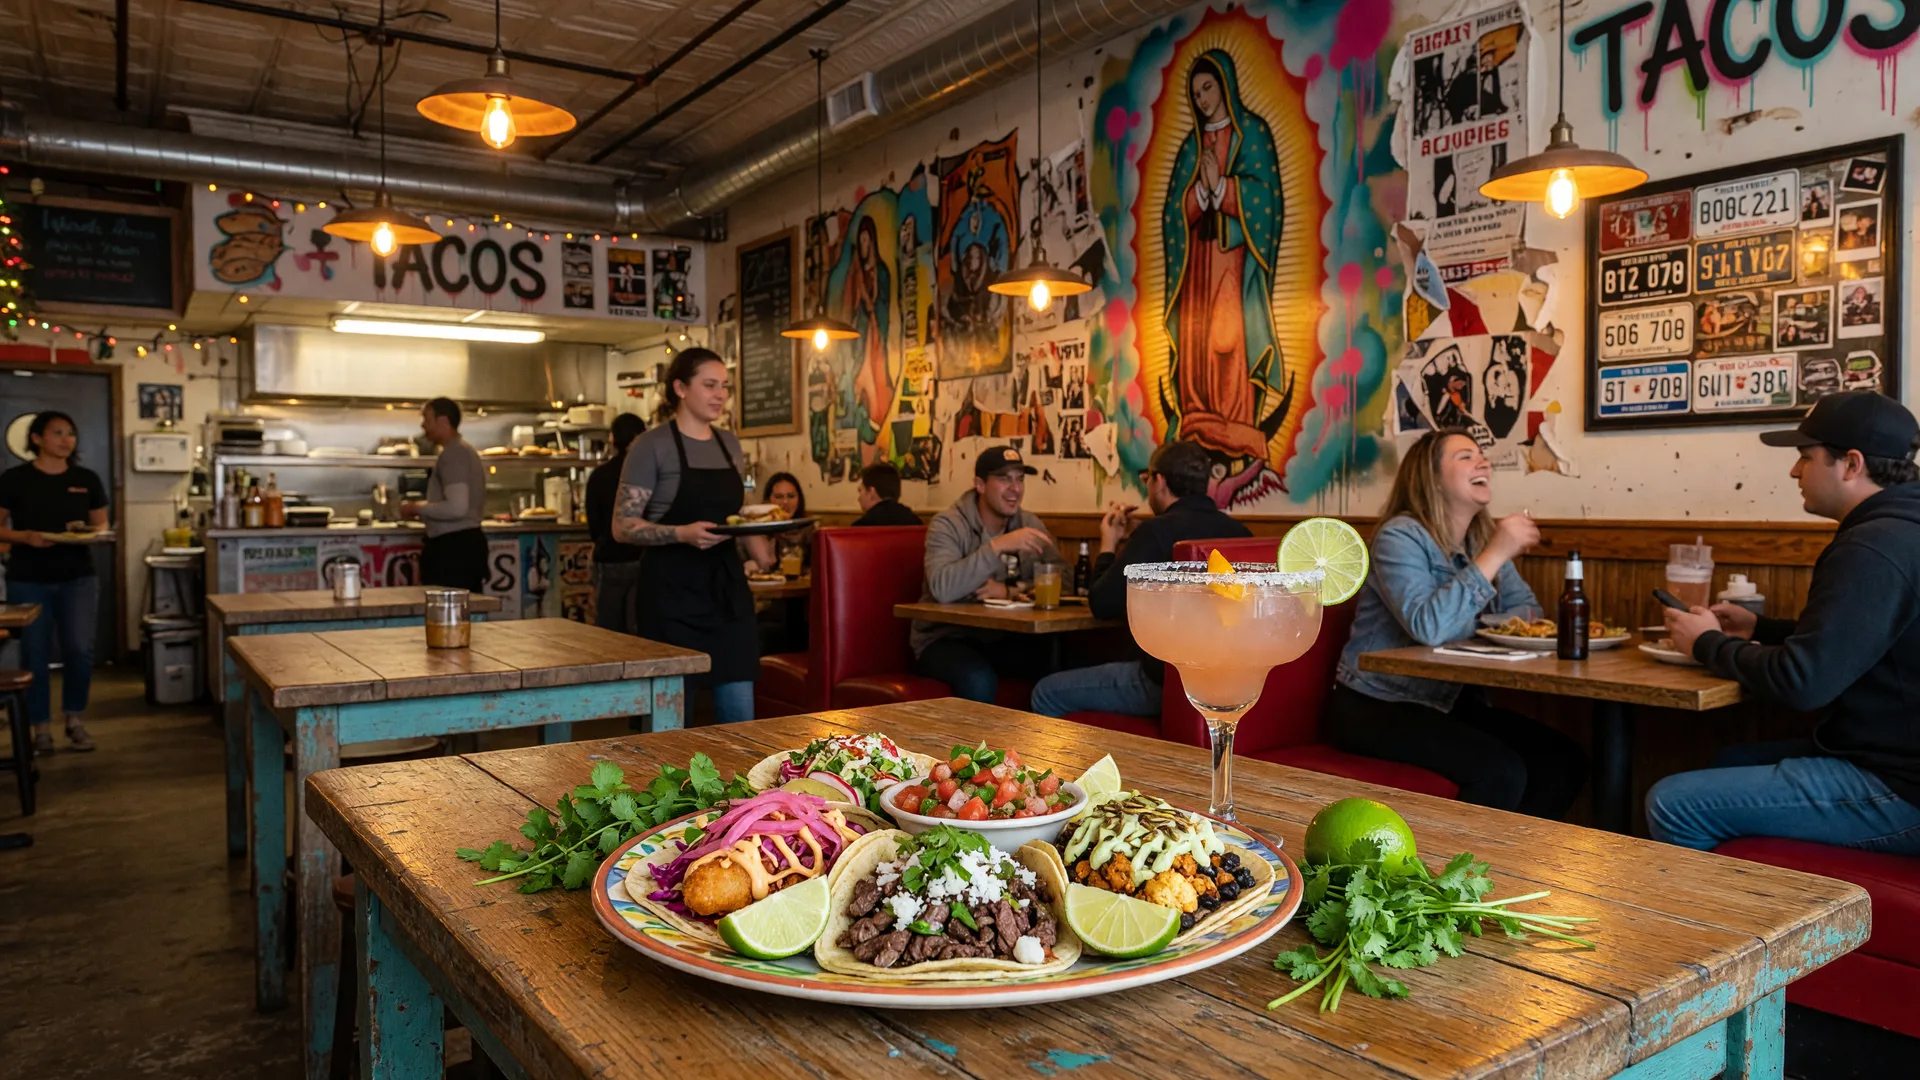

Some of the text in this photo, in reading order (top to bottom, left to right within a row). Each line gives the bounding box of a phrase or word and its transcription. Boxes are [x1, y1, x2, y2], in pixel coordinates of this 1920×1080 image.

[1605, 318, 1685, 347] 506 708
[1649, 376, 1683, 400] 908
